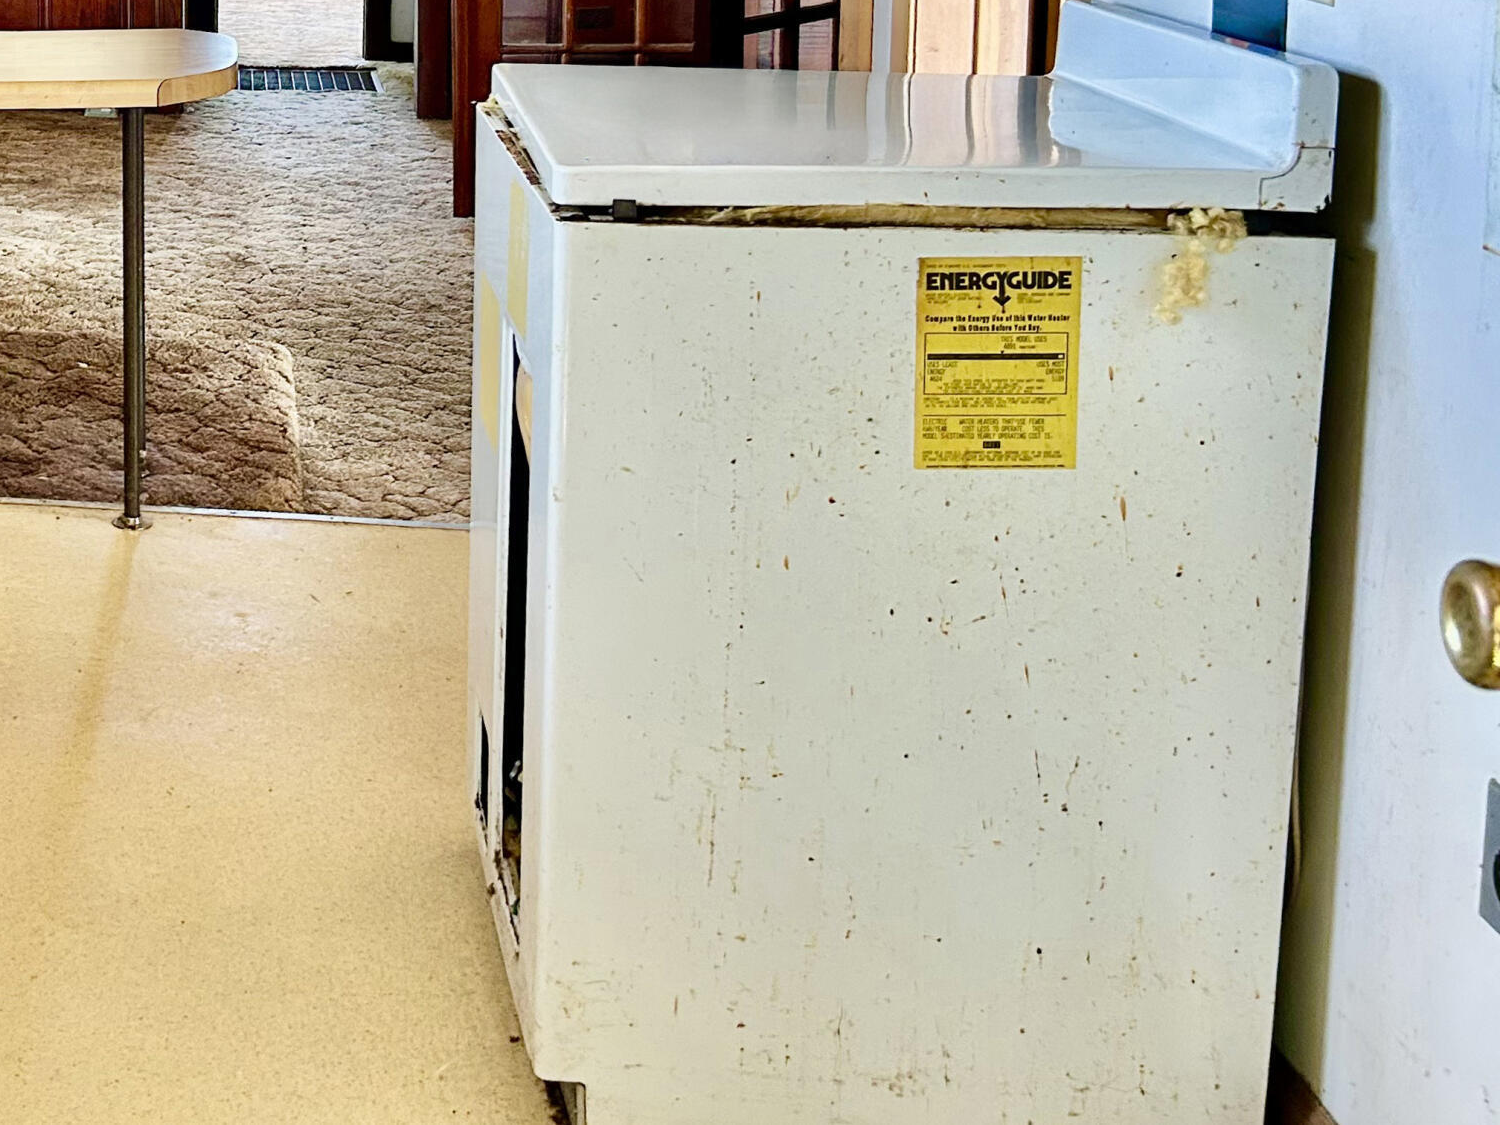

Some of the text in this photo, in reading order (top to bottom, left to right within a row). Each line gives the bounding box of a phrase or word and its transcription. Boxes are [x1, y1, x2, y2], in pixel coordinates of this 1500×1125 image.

[926, 270, 1072, 291] ENERGYGUIDE
[925, 314, 954, 324] Compare
[956, 314, 966, 322] the
[968, 314, 990, 324] Energy
[992, 314, 1003, 322] Use
[1027, 314, 1047, 322] Water
[968, 324, 990, 332] Others
[991, 324, 1012, 332] Before
